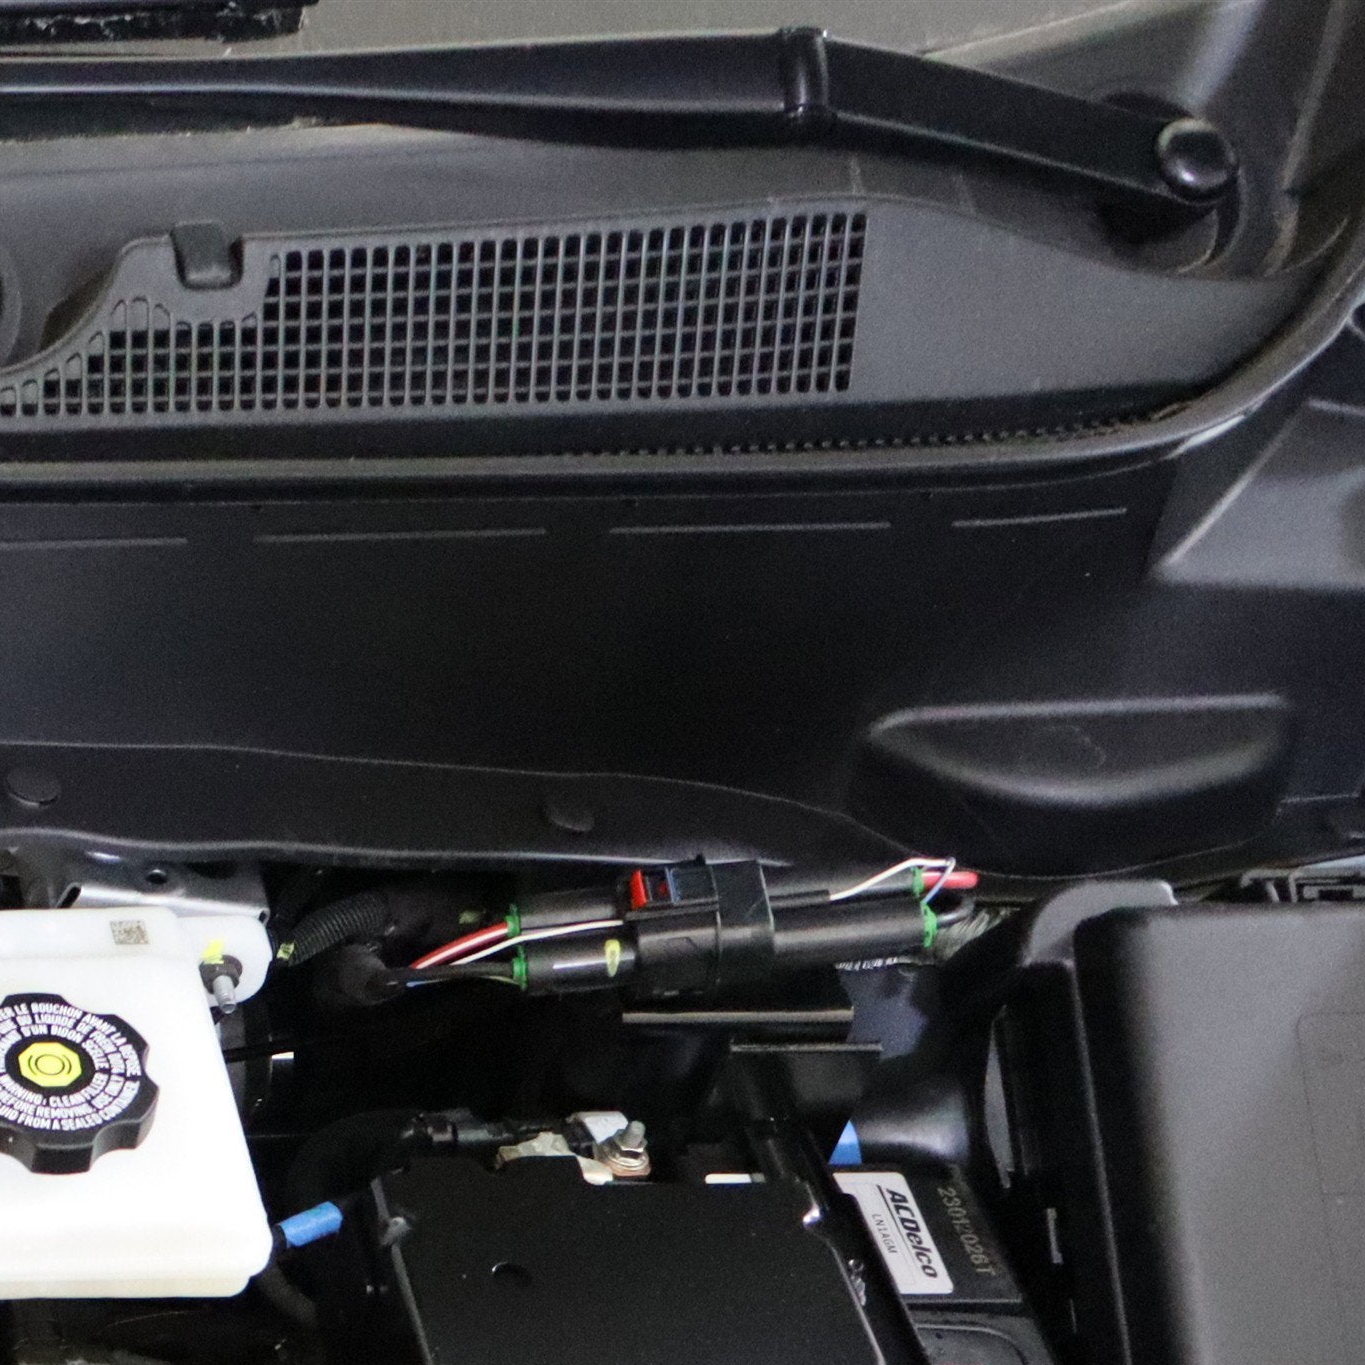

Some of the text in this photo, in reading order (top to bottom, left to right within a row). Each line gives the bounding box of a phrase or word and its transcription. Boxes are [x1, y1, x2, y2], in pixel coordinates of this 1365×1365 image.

[14, 1002, 29, 1016] LE
[31, 1002, 83, 1020] BOUCHON
[80, 1013, 117, 1035] AVANT
[110, 1032, 127, 1046] LA
[21, 1024, 48, 1037] D'UN
[50, 1025, 86, 1044] BIDON
[34, 1013, 77, 1029] LIQUIDE
[76, 1021, 94, 1035] DE
[49, 1092, 86, 1107] CLEAN
[80, 1072, 109, 1100] FILLER
[17, 1112, 51, 1130] FROM
[52, 1119, 61, 1130] A
[60, 1113, 103, 1131] SEALED
[872, 1213, 898, 1253] LN1AGM
[886, 1188, 938, 1279] ACDelco
